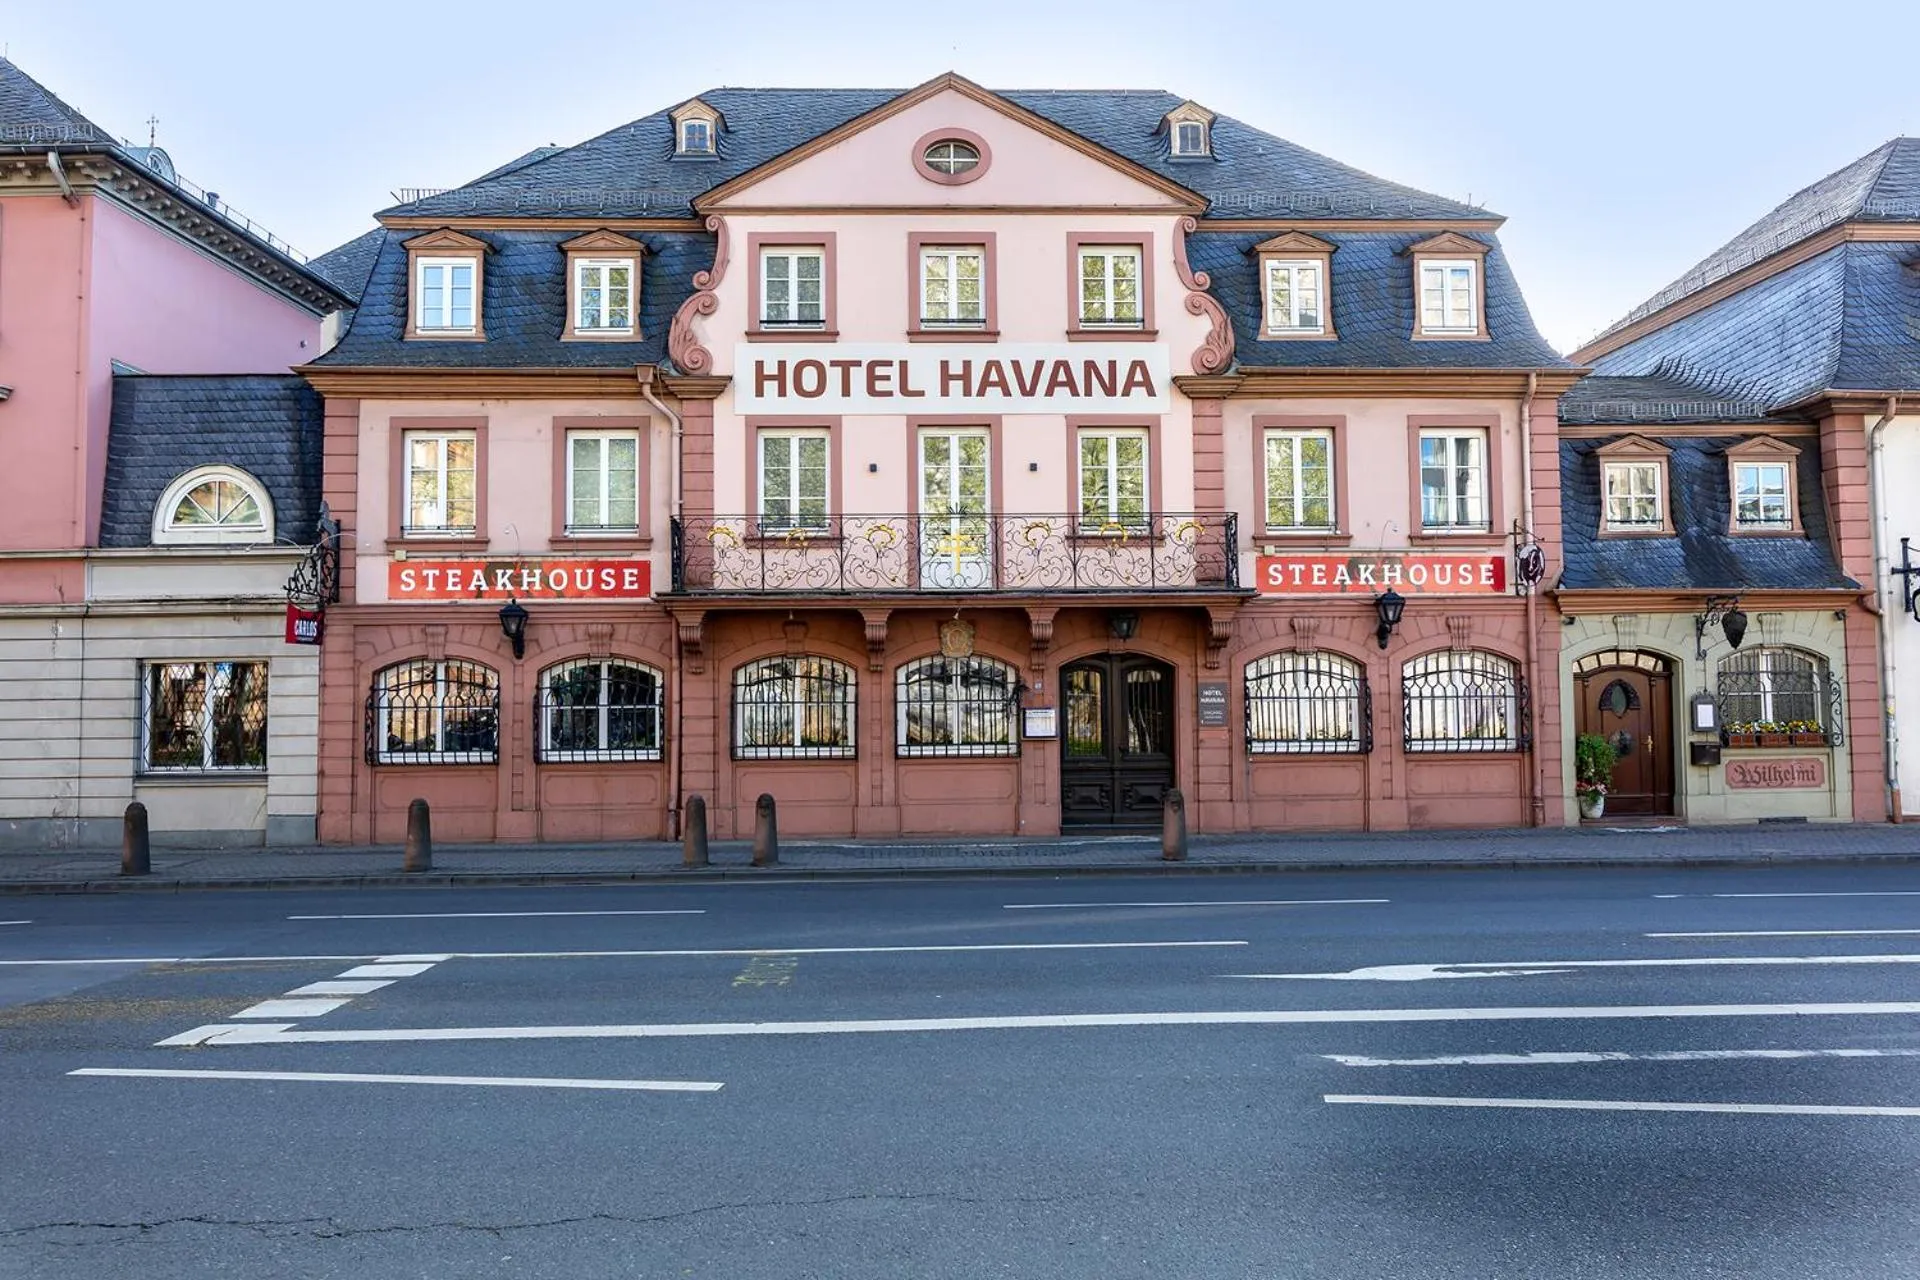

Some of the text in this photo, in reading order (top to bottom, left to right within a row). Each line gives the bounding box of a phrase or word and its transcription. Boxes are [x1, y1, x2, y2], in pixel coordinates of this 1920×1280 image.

[754, 359, 1157, 398] HOTEL HAVANA
[400, 567, 639, 592] STEAKHOUSE
[1267, 563, 1495, 586] STEAKHOUSE
[294, 619, 318, 637] CARLOS
[1731, 763, 1816, 787] Wilhelmi
